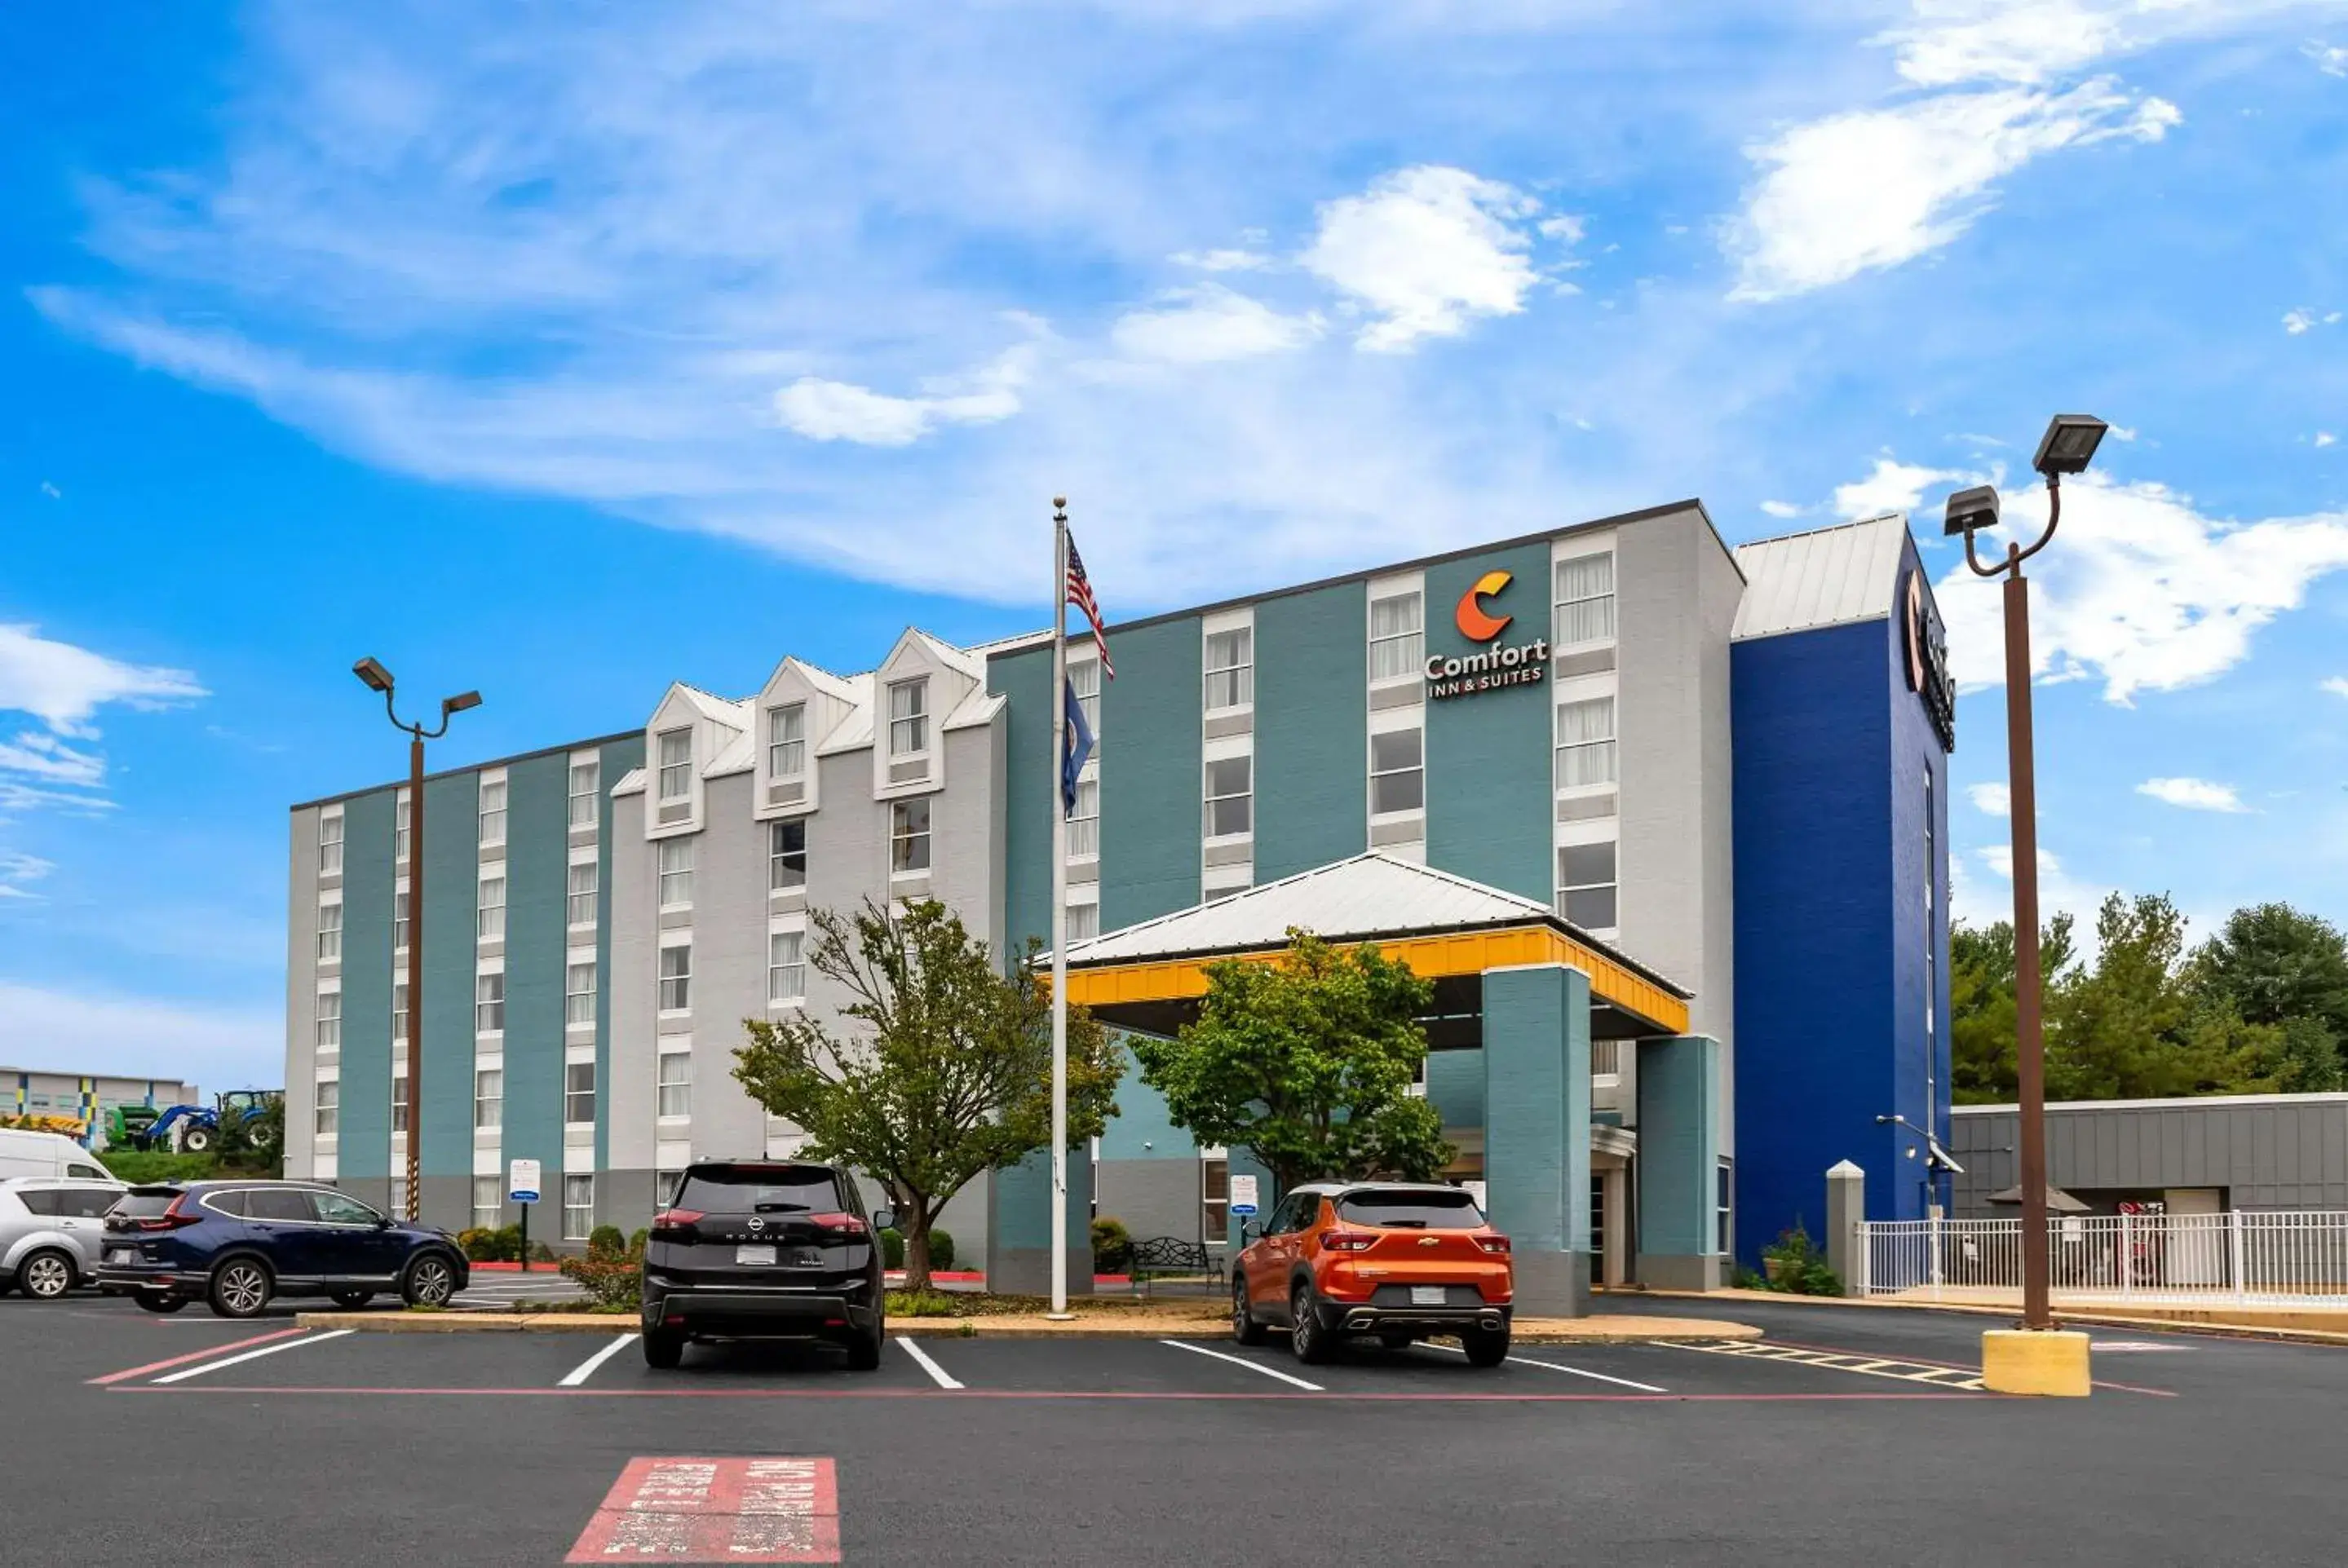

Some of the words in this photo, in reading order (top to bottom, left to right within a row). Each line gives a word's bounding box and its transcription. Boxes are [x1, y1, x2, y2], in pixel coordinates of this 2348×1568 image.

[1425, 638, 1547, 680] Comfort
[1430, 681, 1460, 698] INN
[1464, 678, 1475, 691] &
[1480, 667, 1542, 689] SUITES
[728, 1482, 815, 1553] PARK
